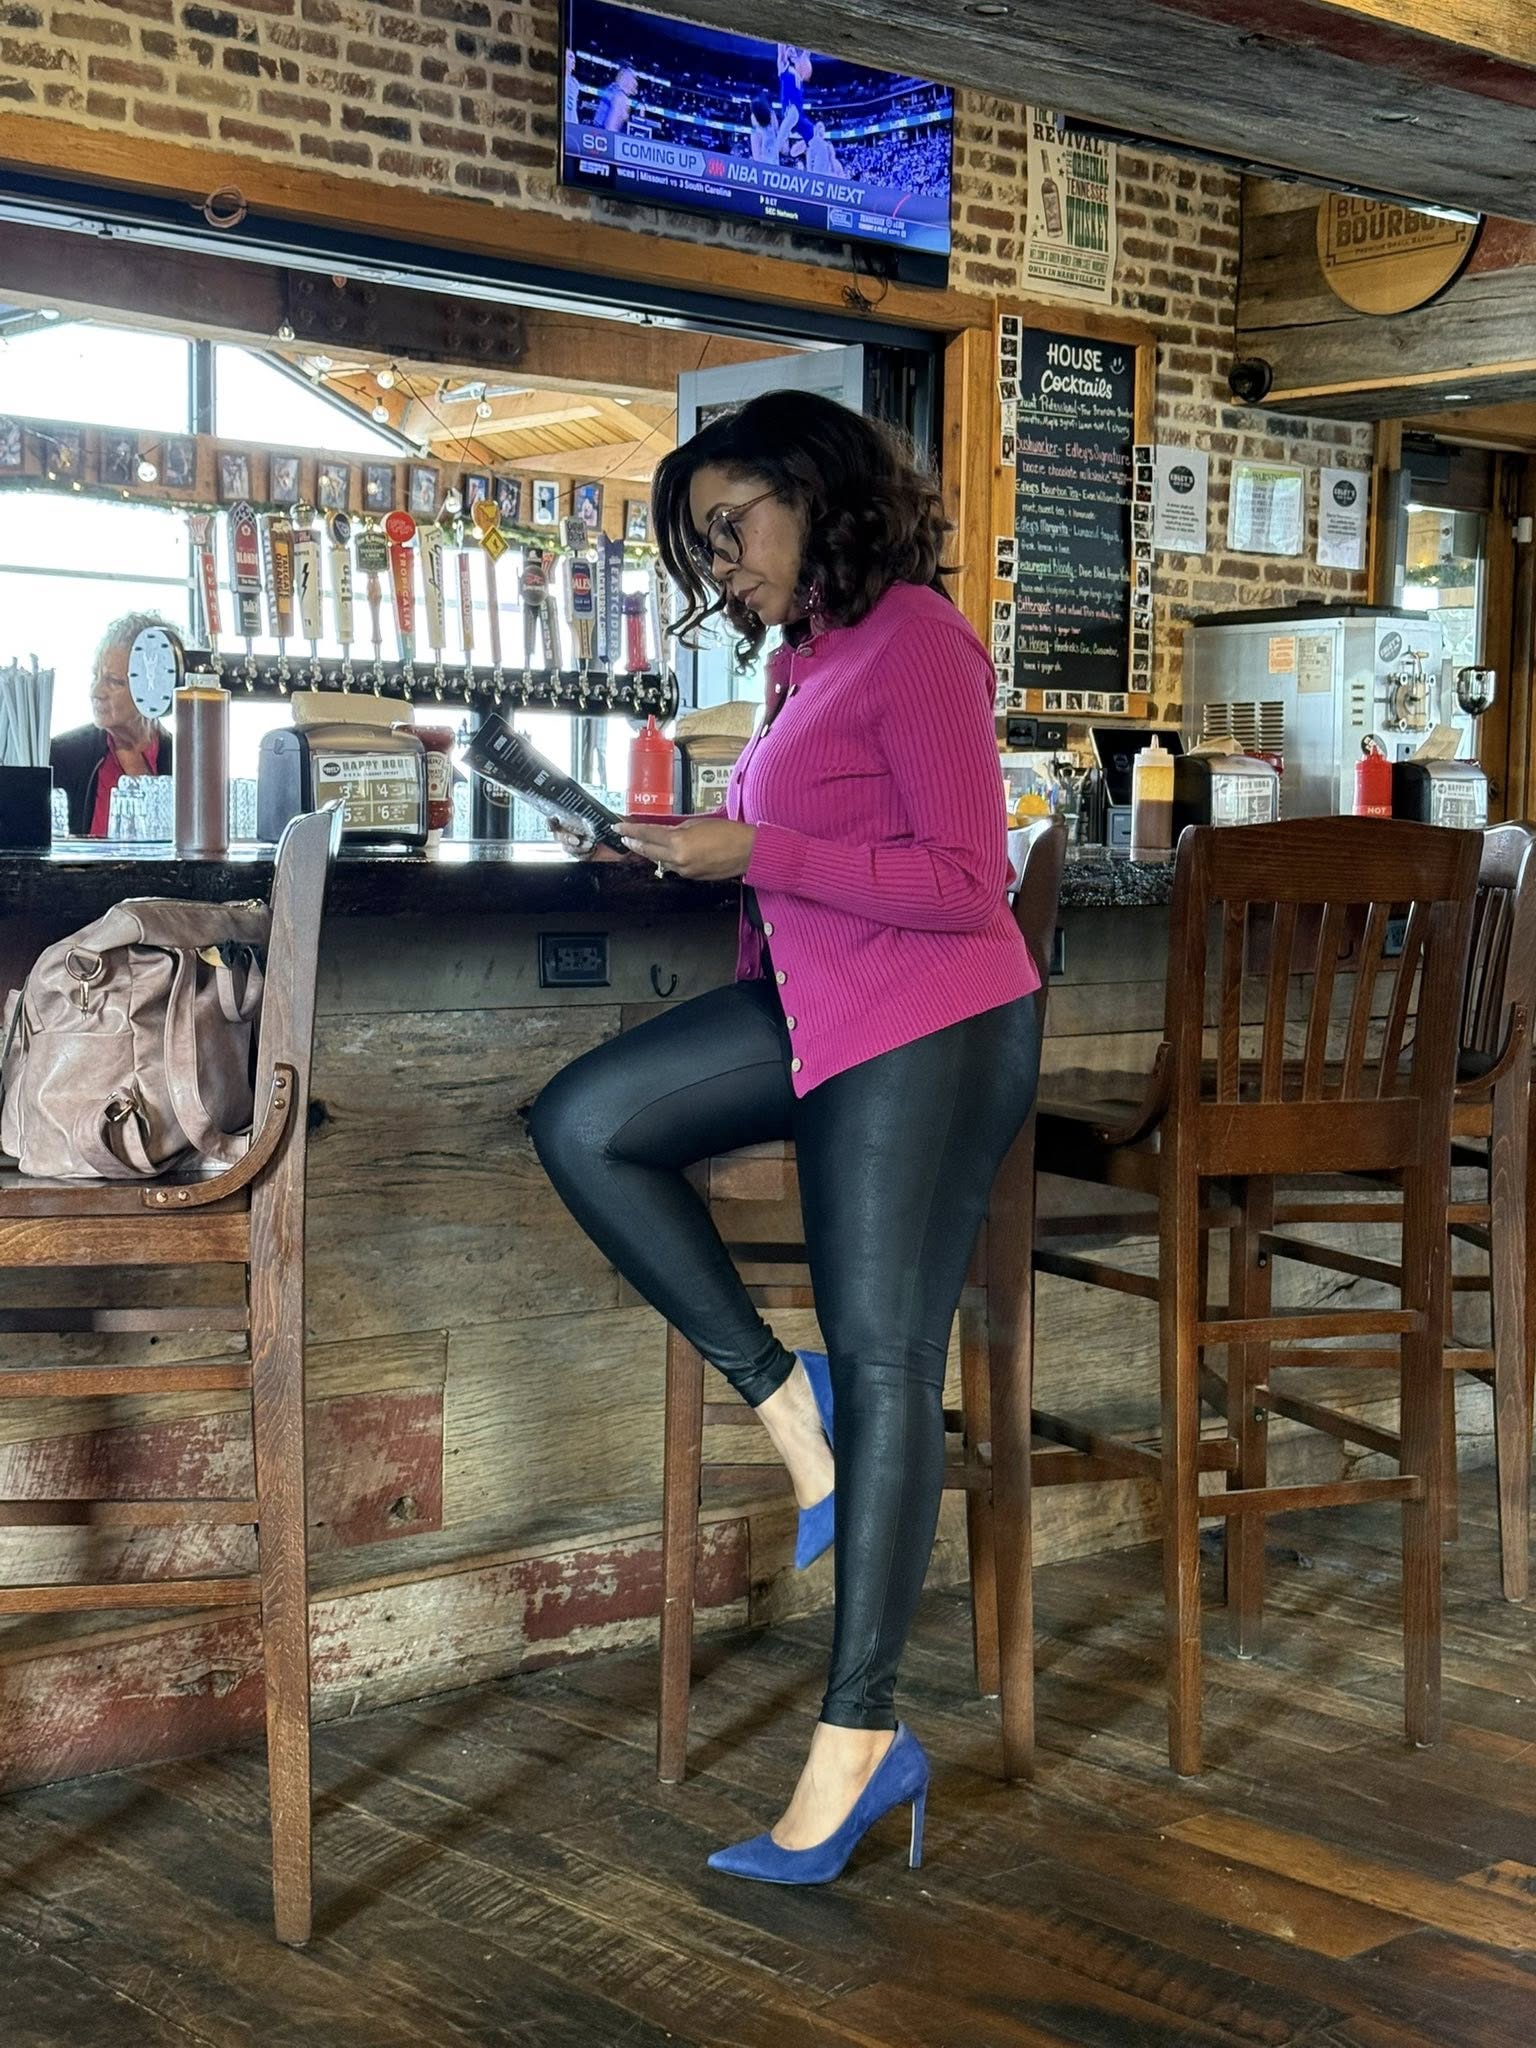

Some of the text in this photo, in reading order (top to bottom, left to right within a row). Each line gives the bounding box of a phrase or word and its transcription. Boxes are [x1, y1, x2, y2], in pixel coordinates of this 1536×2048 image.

[582, 134, 607, 151] SC
[1033, 122, 1102, 155] REVIVAL
[579, 159, 610, 177] ESPN
[621, 142, 697, 169] COMING UP
[640, 172, 669, 186] Missouri
[685, 180, 704, 192] South
[704, 184, 732, 198] Carolina
[727, 163, 865, 205] NBA TODAY IS NEXT
[1028, 265, 1048, 275] ONLY
[1046, 343, 1104, 372] HOUSE
[1041, 370, 1113, 400] Cocktails
[399, 552, 412, 628] TROPICALIA
[609, 566, 621, 661] EASTCIDERS
[342, 760, 379, 772] HAPPY
[634, 793, 659, 804] HOT
[1367, 806, 1387, 815] HOT
